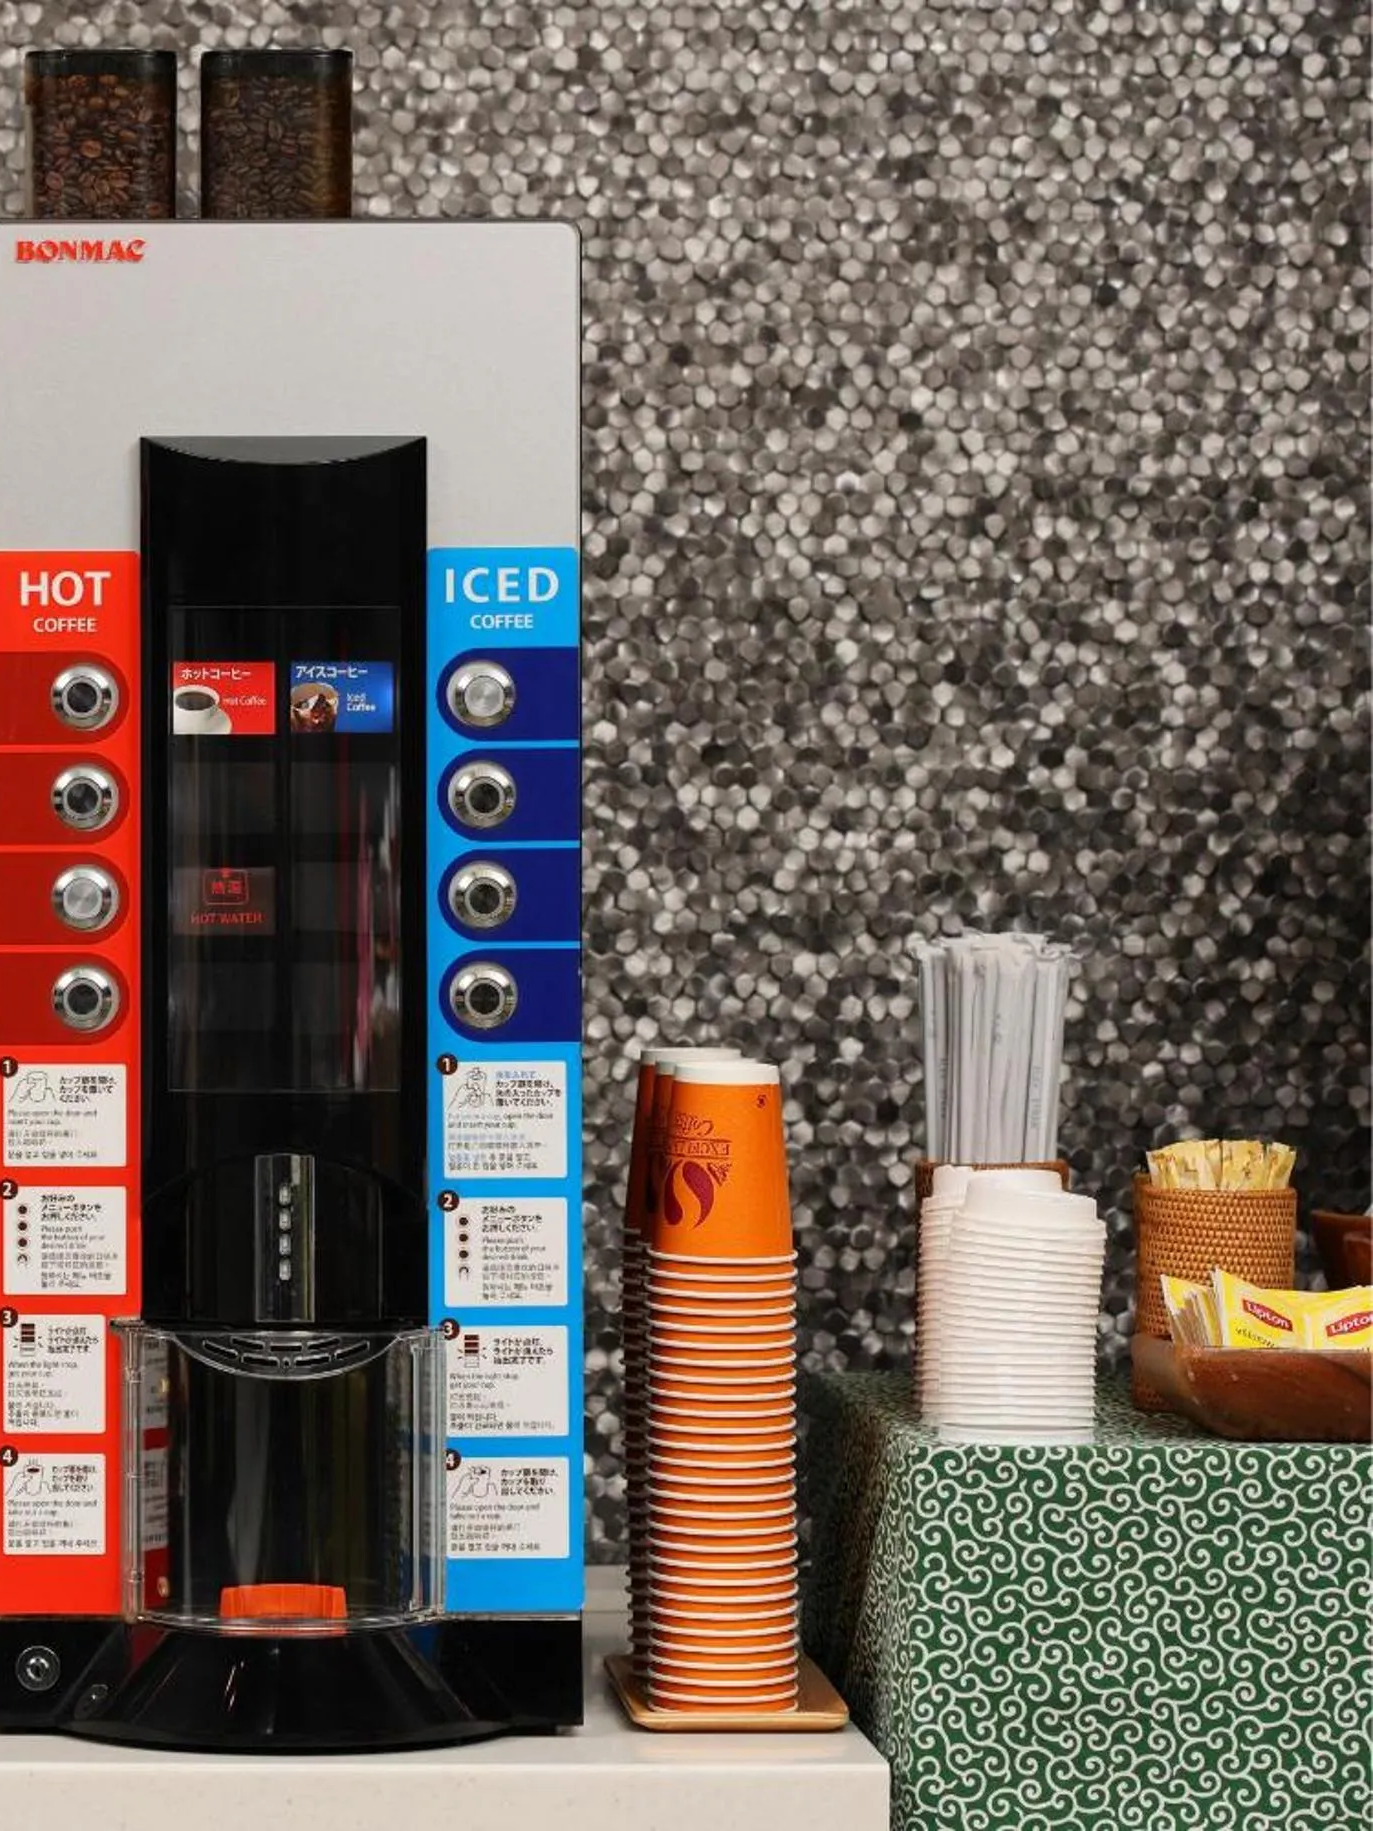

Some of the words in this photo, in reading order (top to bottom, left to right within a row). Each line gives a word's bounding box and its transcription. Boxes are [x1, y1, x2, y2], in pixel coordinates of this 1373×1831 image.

[16, 239, 146, 263] BONMAC
[20, 570, 112, 607] HOT
[444, 566, 560, 604] ICED
[32, 616, 98, 633] COFFEE
[469, 613, 534, 630] COFFEE
[181, 667, 252, 681] ホットコーヒー
[295, 665, 368, 679] アイスコーヒー
[346, 702, 376, 712] Coffee
[2, 1060, 11, 1074] 1
[442, 1058, 451, 1072] 1
[2, 1182, 13, 1197] 2
[443, 1193, 454, 1208] 2
[2, 1310, 12, 1325] 3
[1247, 1302, 1291, 1329] Lipton
[443, 1321, 453, 1336] 3
[2, 1449, 13, 1463] 4
[445, 1453, 455, 1467] 4
